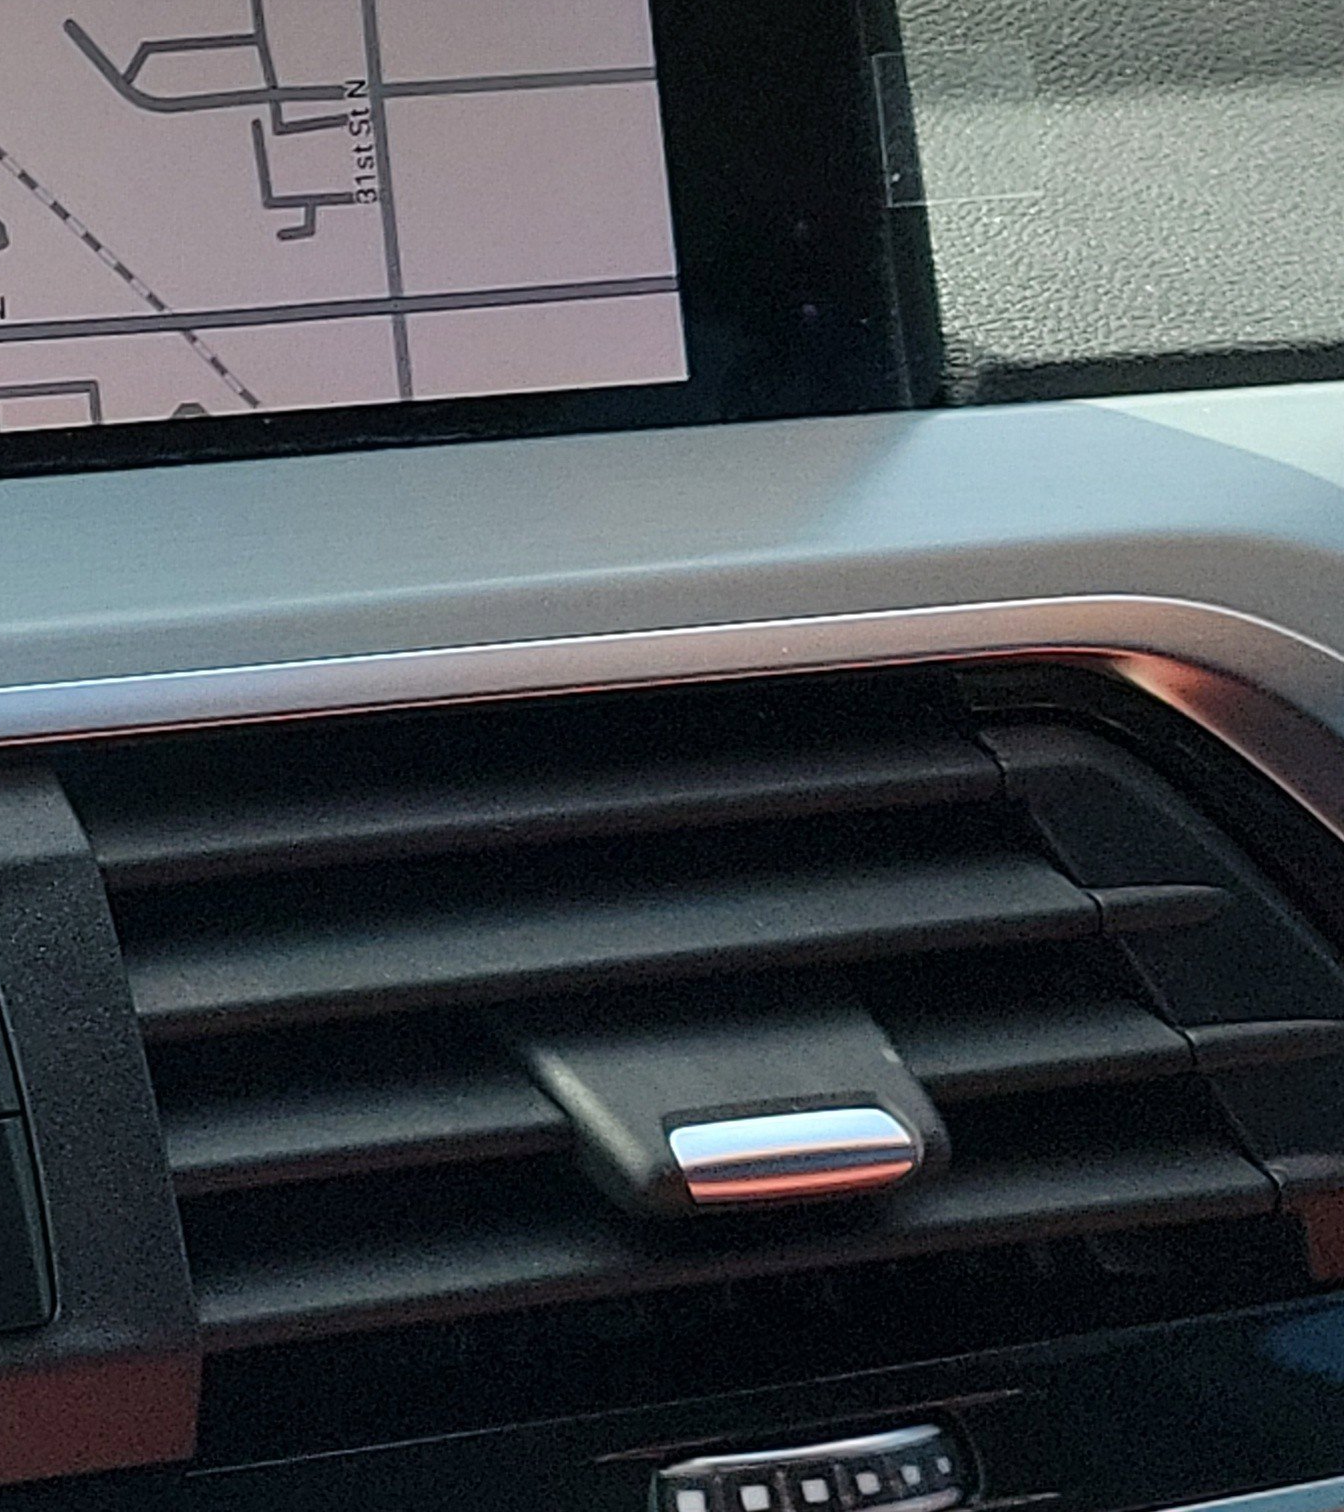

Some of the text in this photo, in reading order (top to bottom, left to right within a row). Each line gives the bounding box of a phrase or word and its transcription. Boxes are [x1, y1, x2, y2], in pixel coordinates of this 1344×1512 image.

[345, 79, 377, 204] 31st St N
